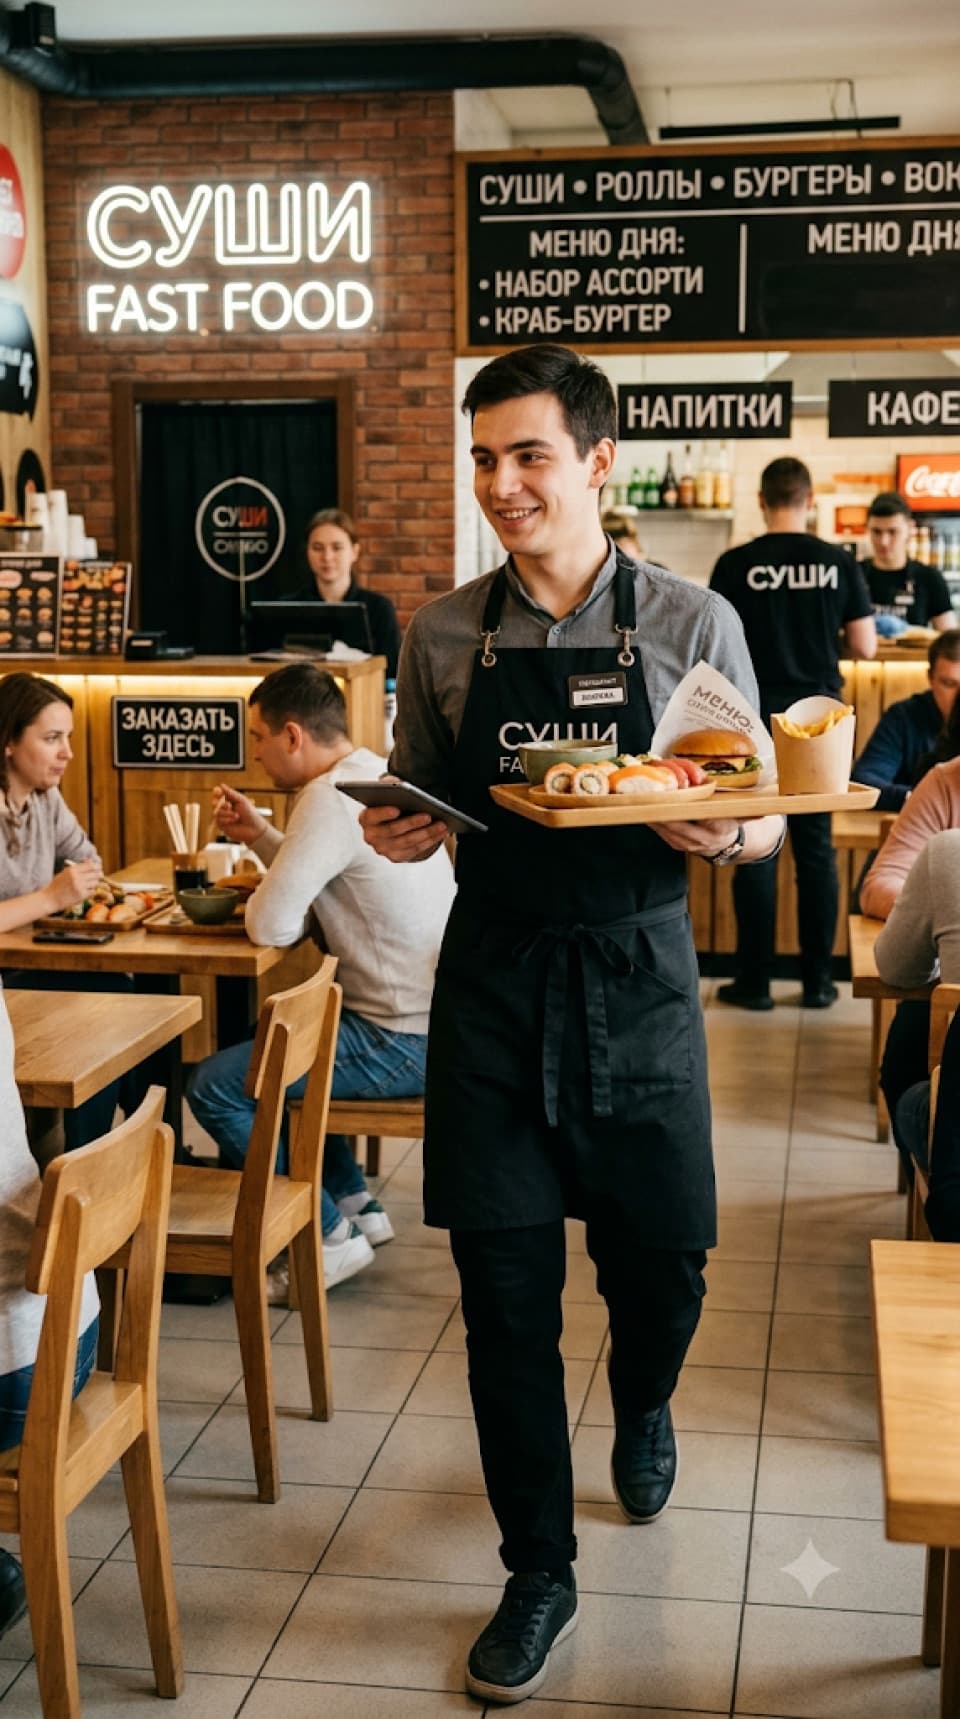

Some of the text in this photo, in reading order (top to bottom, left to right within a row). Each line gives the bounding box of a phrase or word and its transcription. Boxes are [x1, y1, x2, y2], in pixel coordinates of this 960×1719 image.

[480, 173, 564, 205] СУШИ
[596, 169, 701, 201] РОЛЛЫ
[734, 164, 872, 198] БУРГЕРЫ
[86, 180, 372, 269] СУШИ
[808, 221, 901, 254] МЕНЮ
[530, 227, 684, 260] МЕНЮ ДНЯ:
[496, 266, 703, 298] НАБОР АССОРТИ
[87, 280, 374, 333] FAST FOOD
[496, 303, 671, 334] КРАБ-БУРГЕР
[627, 394, 782, 429] НАПИТКИ
[868, 390, 960, 426] КАФЕ
[212, 504, 268, 527] СУШИ
[747, 564, 838, 590] СУШИ
[121, 706, 236, 731] ЗАКАЗАТЬ
[141, 733, 216, 761] ЗДЕСЬ
